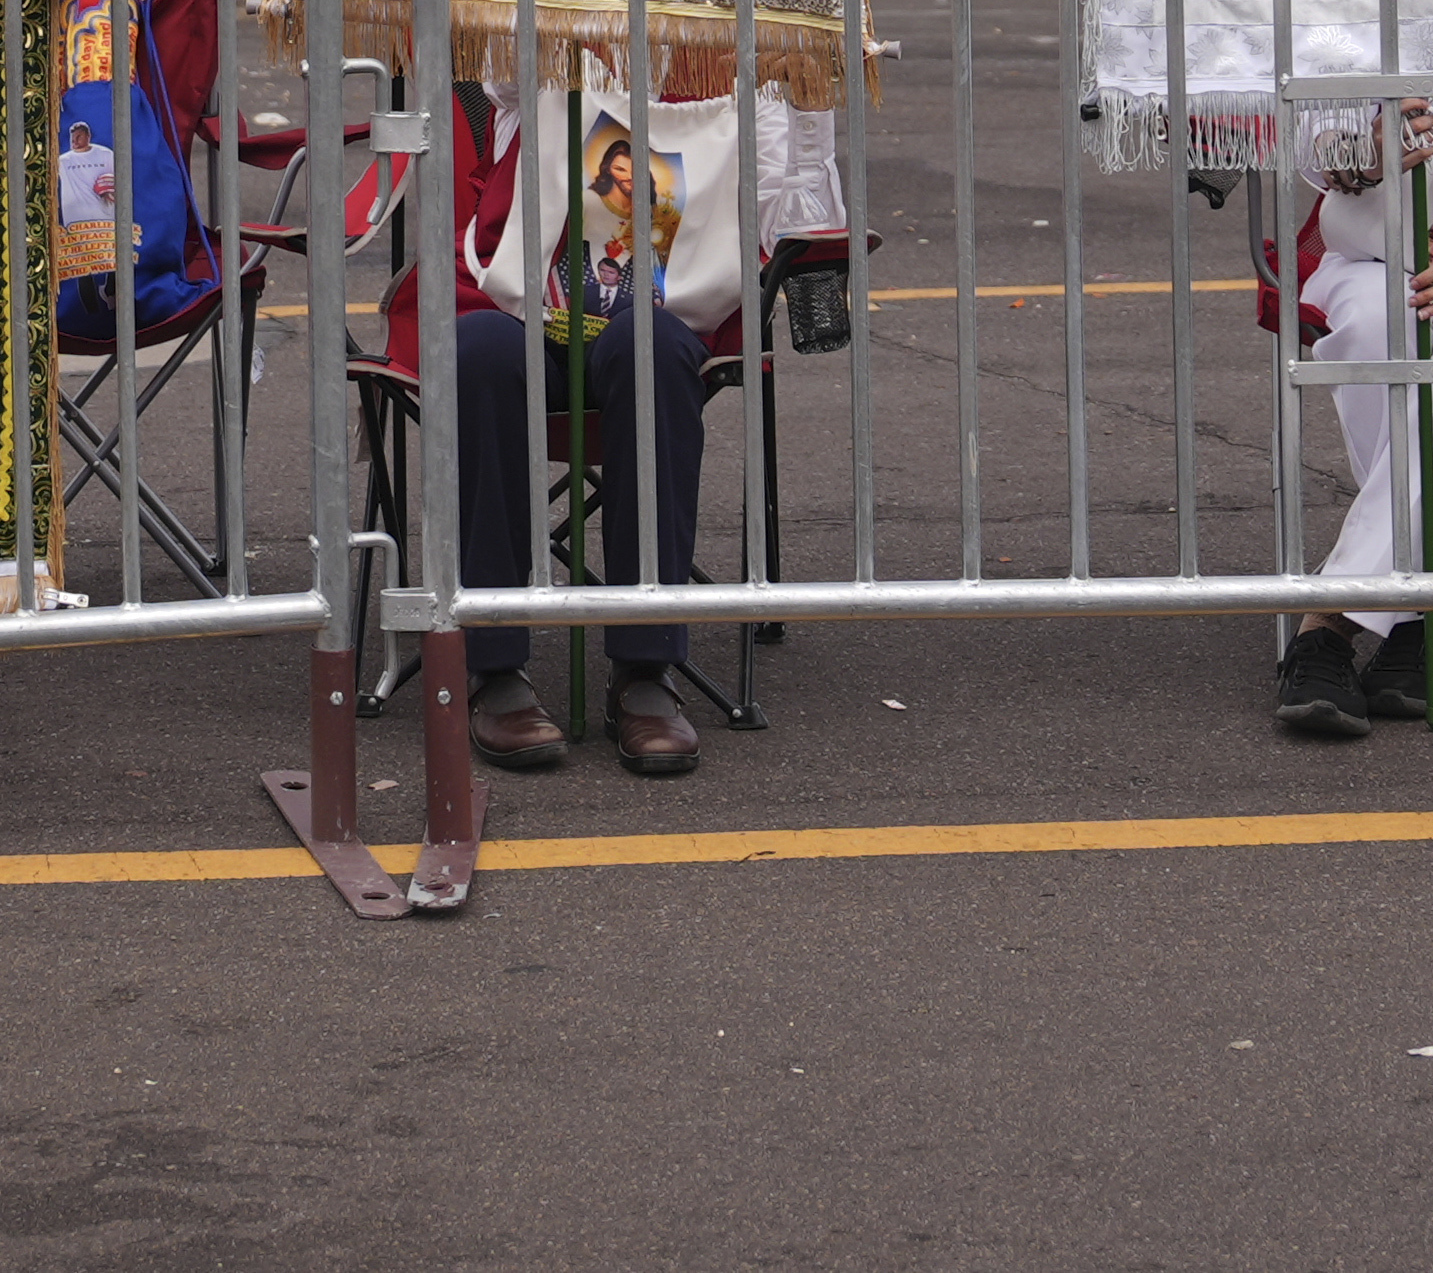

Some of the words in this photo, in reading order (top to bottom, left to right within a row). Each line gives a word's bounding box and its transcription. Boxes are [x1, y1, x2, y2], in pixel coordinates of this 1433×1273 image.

[100, 22, 111, 47] and
[81, 37, 96, 61] day
[69, 221, 113, 232] CHARLIE
[80, 232, 112, 241] PEACE
[85, 242, 111, 251] LEFT
[58, 254, 104, 267] WAVERING
